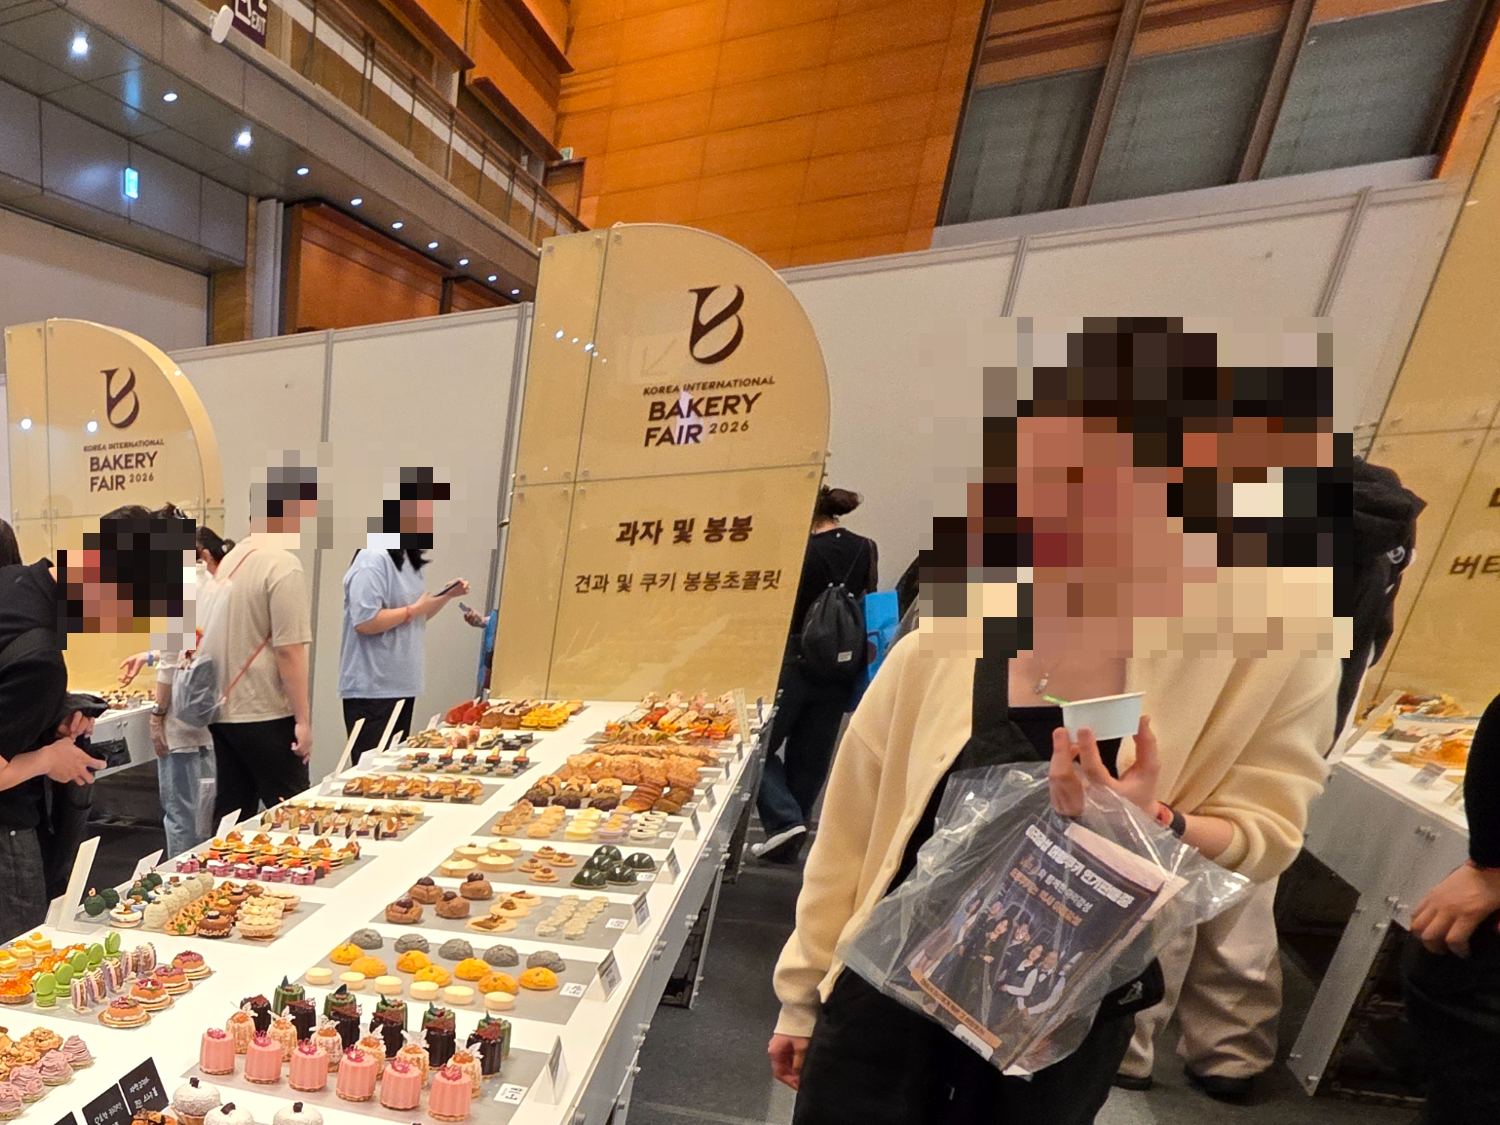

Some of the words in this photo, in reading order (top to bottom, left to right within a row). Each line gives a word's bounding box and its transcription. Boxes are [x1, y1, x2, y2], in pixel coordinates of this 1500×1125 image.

[643, 385, 680, 396] KOREA
[683, 376, 776, 392] INTERNATIONAL
[648, 391, 762, 421] BAKERY
[644, 424, 703, 447] FAIR
[708, 420, 750, 434] 2026
[83, 443, 107, 452] KOREA
[108, 439, 165, 450] INTERNATIONAL
[90, 451, 158, 472] BAKERY
[90, 474, 126, 493] FAIR
[129, 473, 154, 483] 2026
[616, 519, 664, 546] 과자
[672, 517, 695, 544] 및
[703, 515, 753, 543] 봉봉
[574, 573, 610, 594] 견과
[616, 573, 633, 593] 및
[639, 571, 677, 593] 쿠키
[683, 569, 782, 592] 봉봉초콜릿
